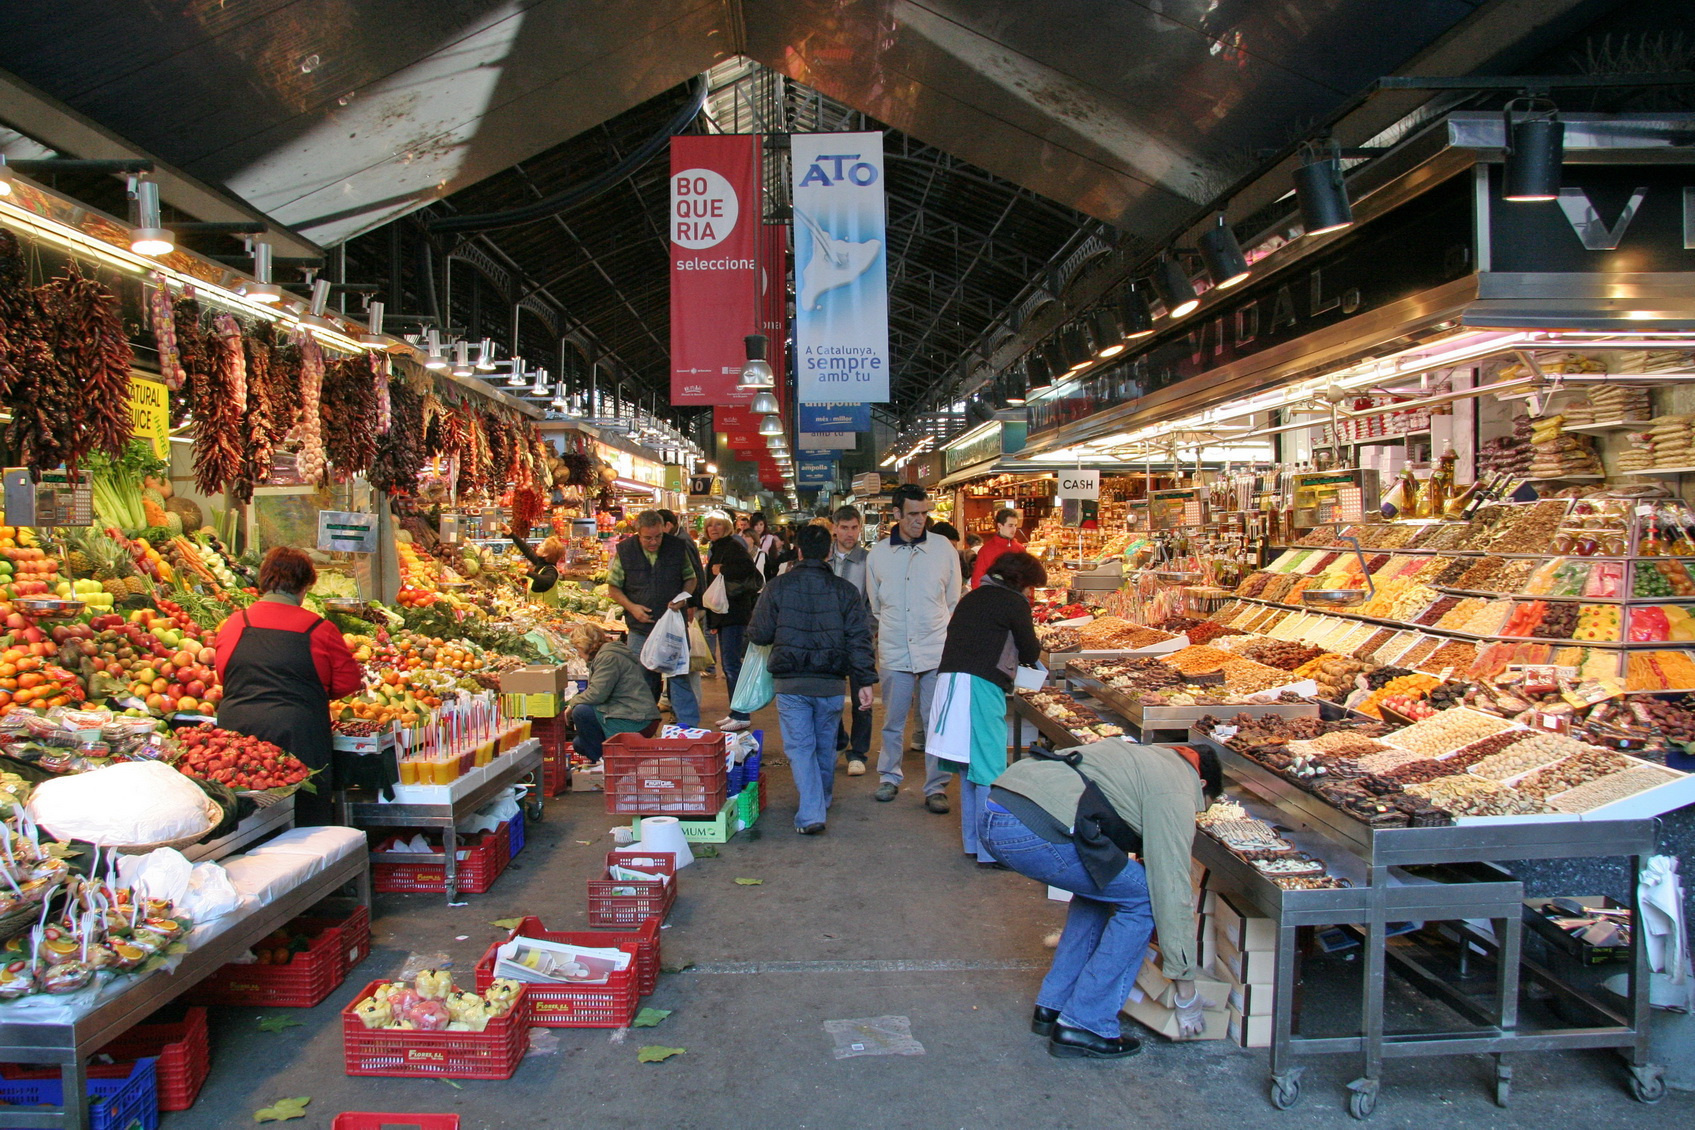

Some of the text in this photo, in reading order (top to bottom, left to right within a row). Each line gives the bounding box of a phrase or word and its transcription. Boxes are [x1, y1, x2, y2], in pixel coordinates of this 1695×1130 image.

[799, 154, 879, 187] ATO
[677, 177, 707, 196] BO
[676, 199, 724, 218] QUE
[677, 222, 716, 241] RIA
[805, 345, 876, 356] A Catalunya,
[807, 357, 882, 373] sempre
[818, 370, 870, 382] amb tu
[127, 384, 160, 407] ATURAL
[1063, 479, 1093, 490] CASH
